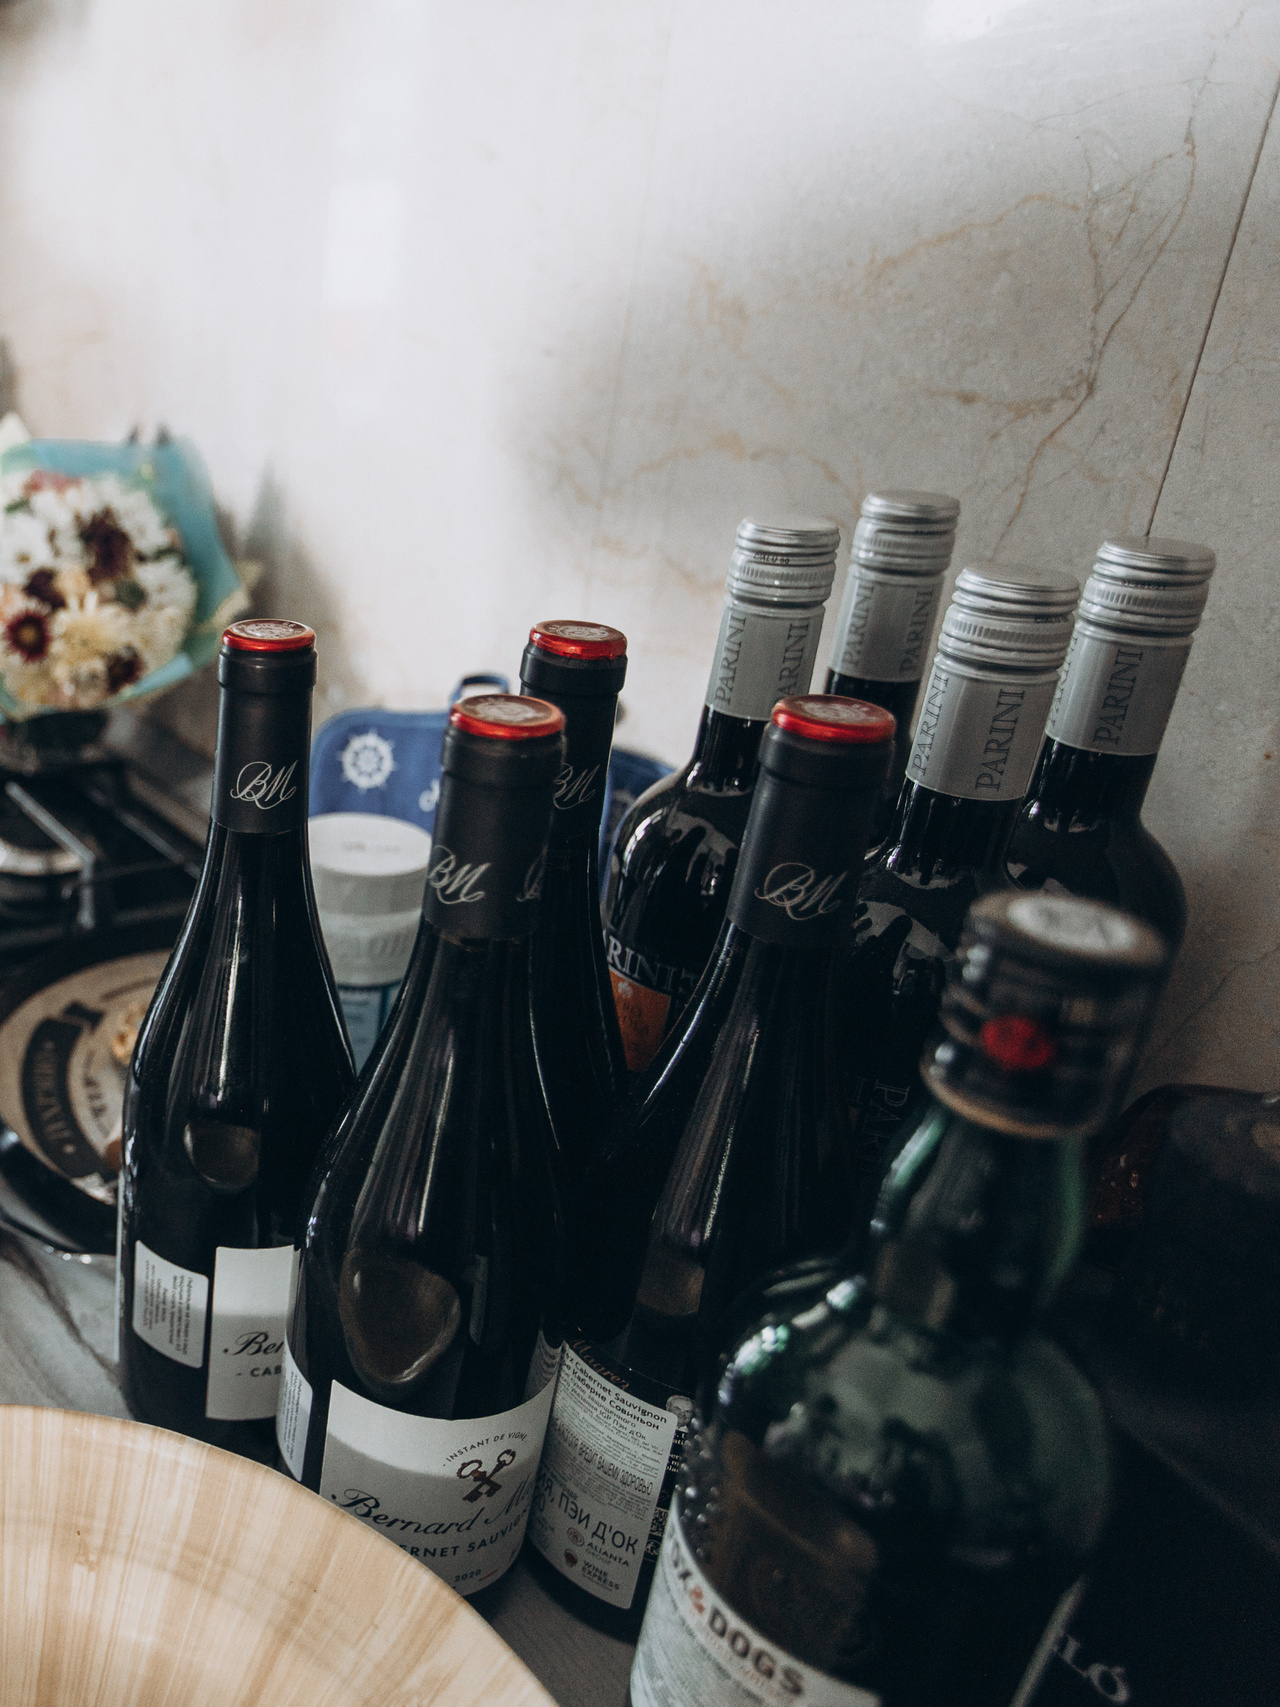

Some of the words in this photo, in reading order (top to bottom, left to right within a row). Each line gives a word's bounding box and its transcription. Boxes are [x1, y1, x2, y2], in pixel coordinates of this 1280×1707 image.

[843, 583, 874, 667] PARINI
[900, 591, 933, 672] PARINI
[715, 615, 746, 706] PARINI
[911, 671, 949, 777] PARINI
[1093, 650, 1144, 745] PARINI
[975, 688, 1026, 792] PARINI
[604, 931, 679, 992] RINI
[571, 1367, 608, 1404] Каберне
[608, 1399, 661, 1432] Совиньон
[574, 1360, 613, 1397] Cabernet
[614, 1389, 669, 1425] Sauvignon
[446, 1437, 490, 1462] INSTANT
[493, 1433, 506, 1442] DE
[331, 1488, 486, 1535] Bernard
[620, 1469, 653, 1496] ЗДОРОВЬЮ
[558, 1491, 591, 1531] ПЭИ
[591, 1521, 640, 1556] Д'ОК
[587, 1541, 630, 1567] ALIANTA
[454, 1568, 482, 1583] 2020
[581, 1566, 620, 1591] EXPRESS
[582, 1559, 609, 1578] WINE
[707, 1605, 805, 1697] DOGS
